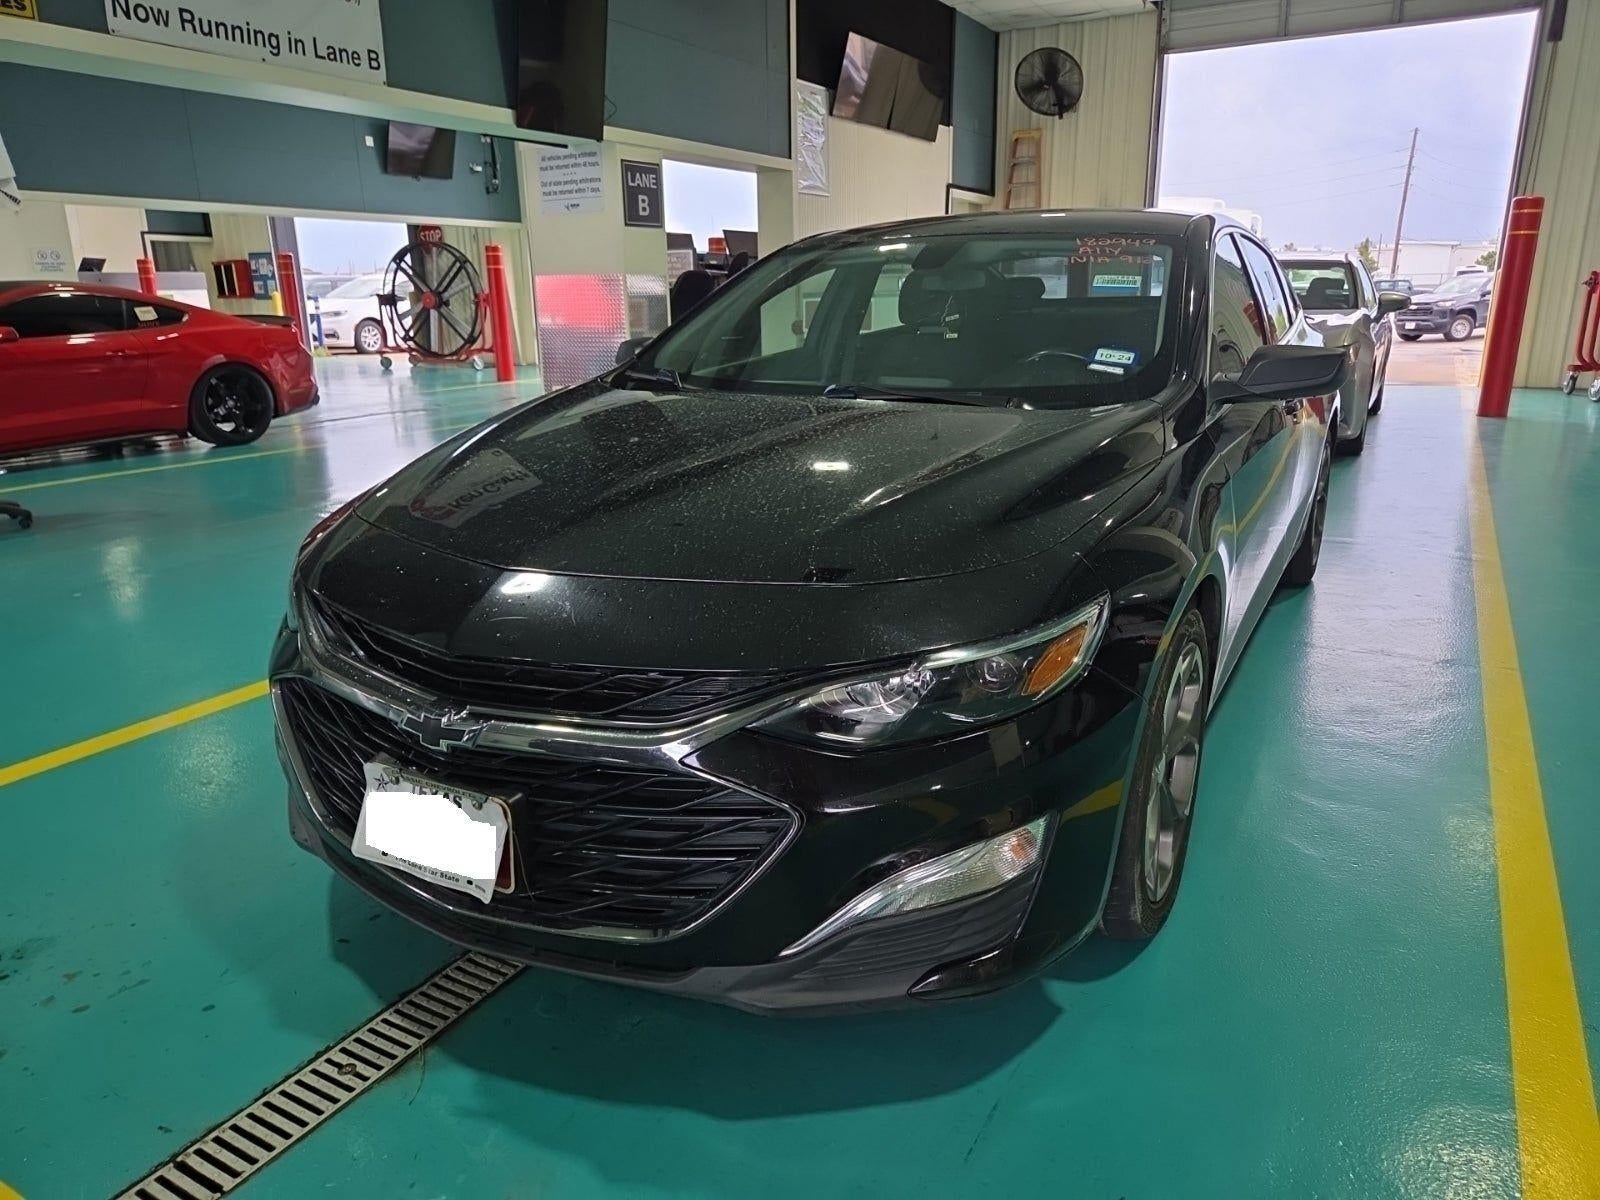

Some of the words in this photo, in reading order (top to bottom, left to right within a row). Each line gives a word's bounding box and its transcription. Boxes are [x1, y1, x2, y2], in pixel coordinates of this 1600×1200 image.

[111, 0, 169, 28] Now
[178, 7, 281, 57] Running
[287, 30, 306, 57] in
[313, 36, 361, 67] Lane
[367, 48, 381, 71] B
[627, 171, 657, 189] LANE
[638, 194, 650, 216] B
[420, 229, 442, 241] STOP
[440, 872, 460, 883] State
